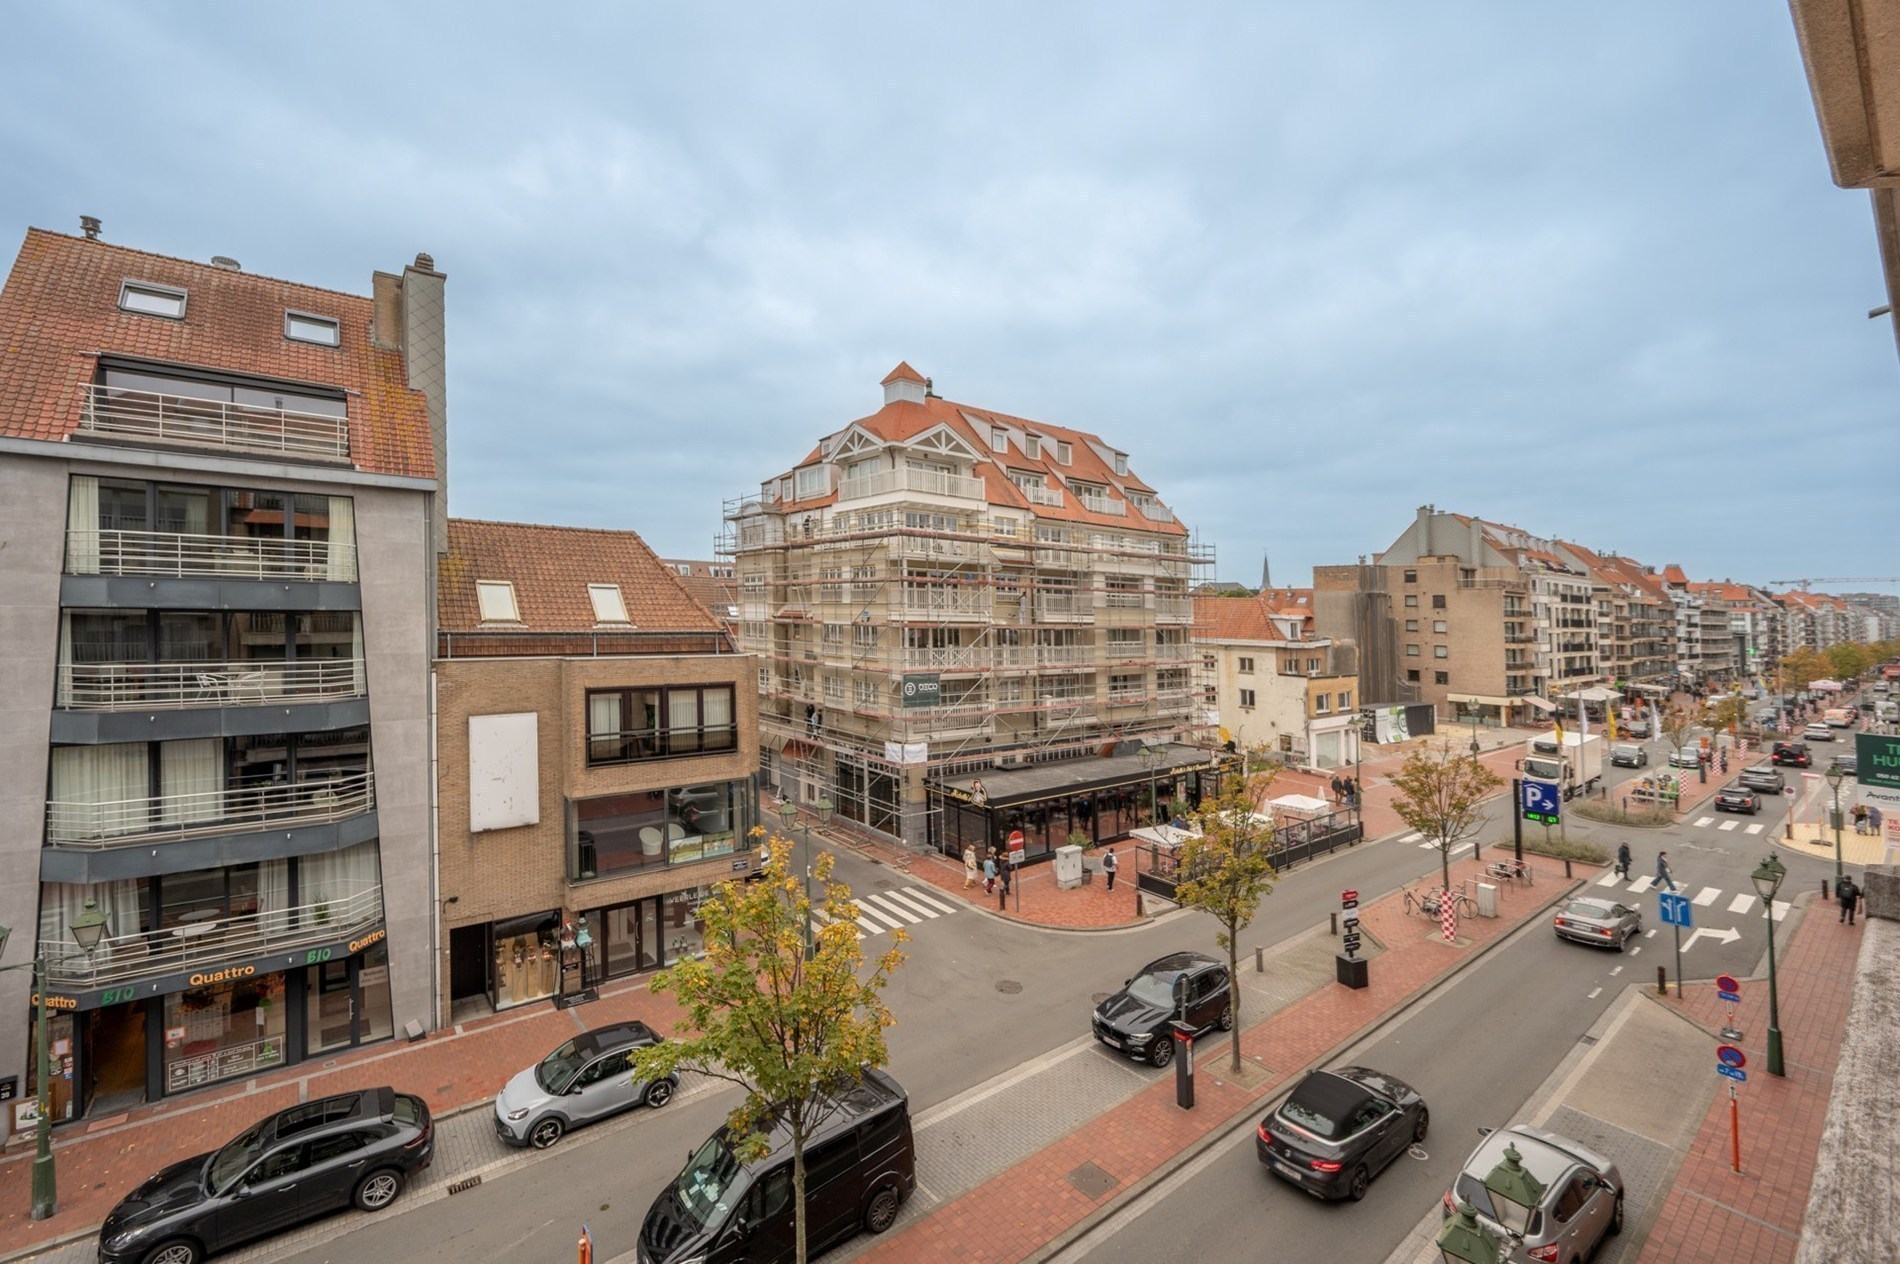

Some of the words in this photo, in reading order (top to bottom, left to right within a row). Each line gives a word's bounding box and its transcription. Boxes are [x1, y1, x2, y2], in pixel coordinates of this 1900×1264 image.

[1872, 754, 1900, 767] HU
[1526, 787, 1542, 808] P
[349, 928, 385, 952] Quattro
[306, 947, 332, 964] BIO
[189, 965, 255, 986] Quattro
[103, 986, 135, 1004] BIO
